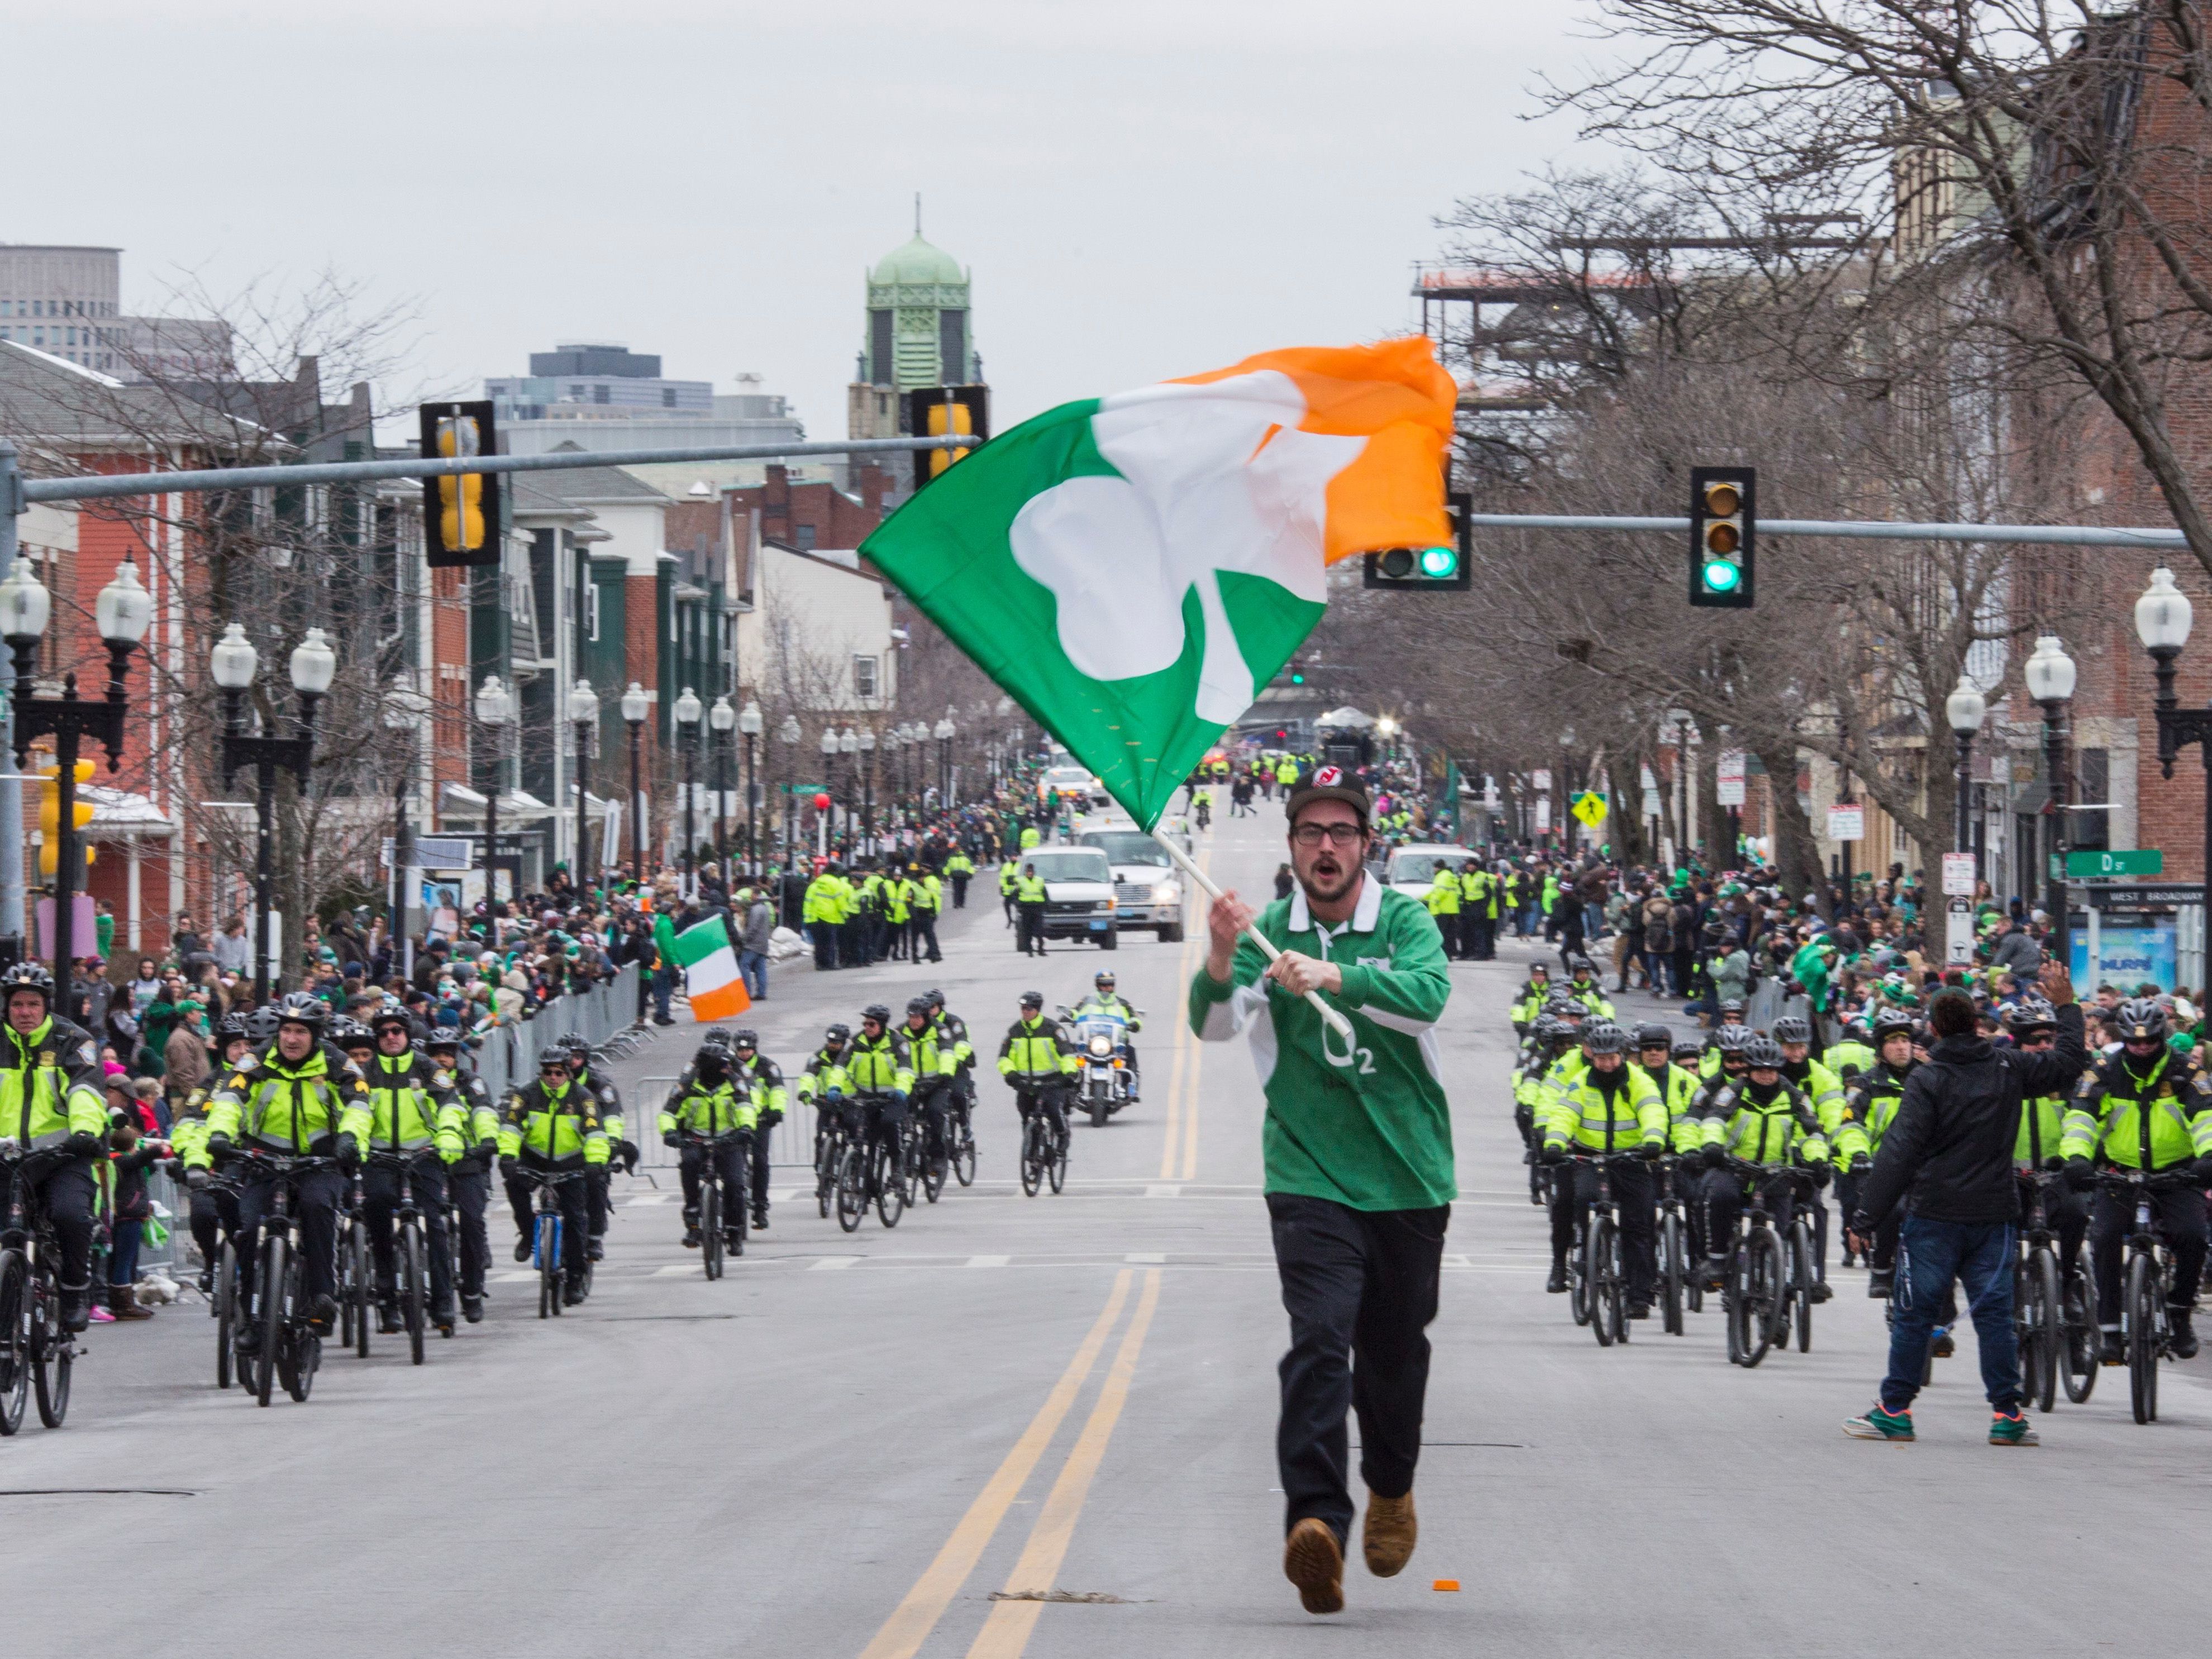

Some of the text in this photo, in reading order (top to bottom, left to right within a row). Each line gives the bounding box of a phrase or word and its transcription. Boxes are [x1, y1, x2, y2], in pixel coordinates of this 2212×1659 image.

[2101, 854, 2113, 871] D
[2110, 892, 2205, 901] WEST BROADWAY
